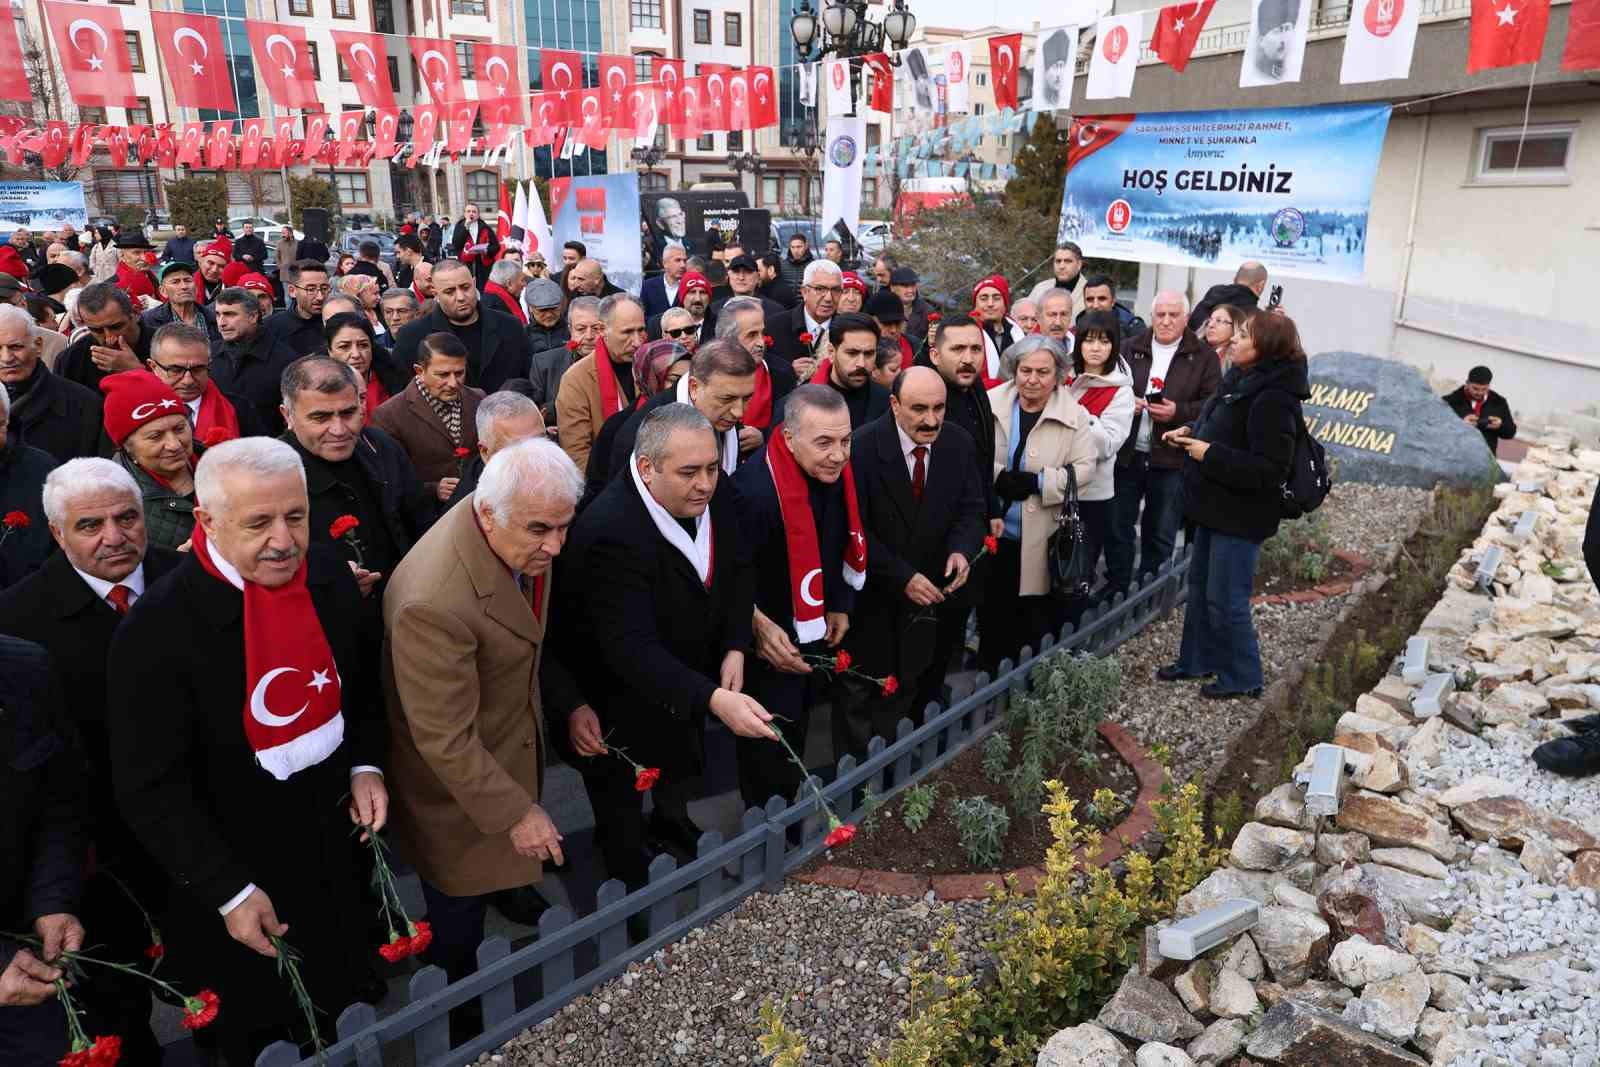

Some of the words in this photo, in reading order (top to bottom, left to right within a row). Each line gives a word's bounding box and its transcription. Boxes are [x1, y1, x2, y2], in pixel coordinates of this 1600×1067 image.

[1247, 121, 1292, 132] RAHMET,
[1193, 136, 1204, 145] VE
[1122, 169, 1168, 196] HOŞ
[1174, 163, 1293, 193] GELDİNİZ
[1315, 421, 1395, 454] ANISINA
